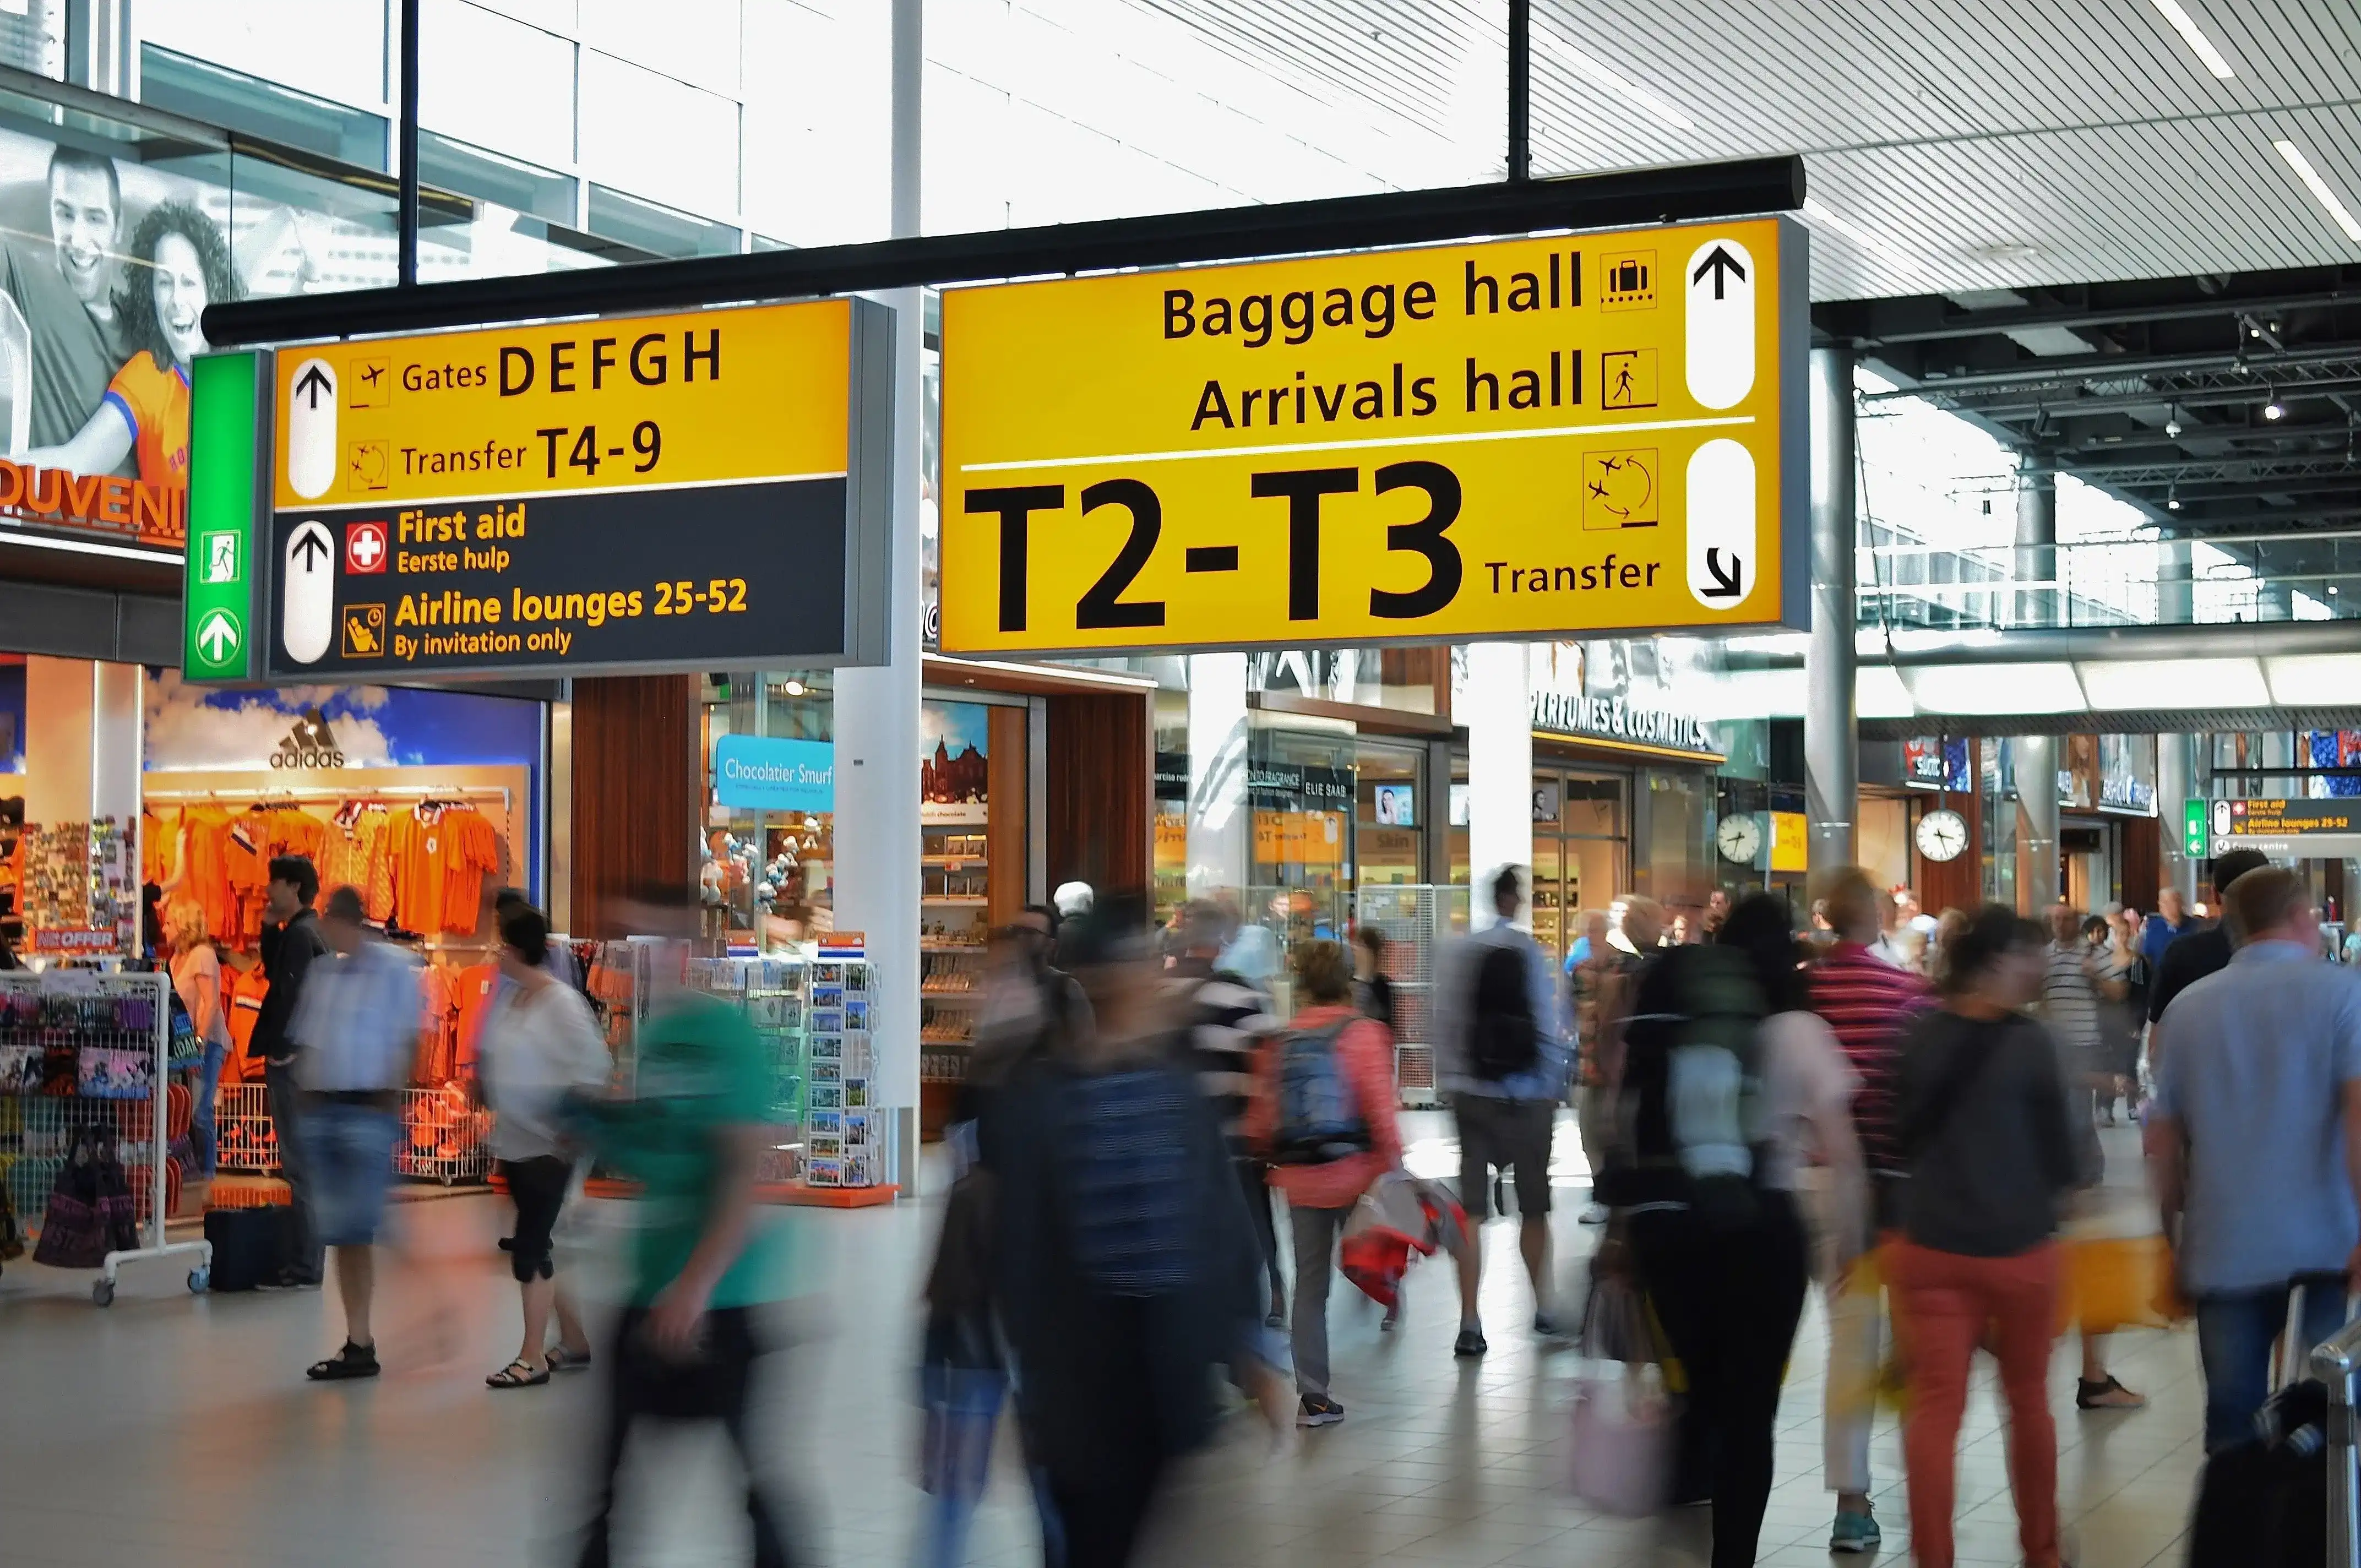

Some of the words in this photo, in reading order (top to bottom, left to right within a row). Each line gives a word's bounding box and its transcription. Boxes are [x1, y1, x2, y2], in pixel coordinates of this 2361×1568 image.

[1163, 277, 1437, 348] Baggage
[1465, 251, 1582, 316] hall
[402, 362, 487, 391] Gates
[1190, 363, 1438, 431] Arrivals
[1465, 349, 1583, 412] hall
[401, 440, 527, 475] Transfer
[536, 421, 661, 478] T4-9
[399, 510, 466, 543] First
[476, 503, 525, 540] aid
[398, 551, 458, 573] Eerste
[465, 545, 510, 573] hulp
[965, 460, 1463, 632] T2-T3
[1485, 554, 1660, 594] Transfer
[395, 591, 501, 626] Airline
[513, 587, 643, 627] lounges
[654, 579, 747, 615] 25-52
[395, 634, 418, 661] By
[425, 630, 520, 655] invitation
[527, 627, 572, 655] only
[1626, 710, 1709, 746] COSMETICS
[270, 747, 345, 768] adidas
[725, 758, 795, 783] Chocolatier
[798, 763, 833, 785] Smurf
[1305, 782, 1324, 796] ELIE
[1326, 783, 1347, 798] SAAB
[1377, 832, 1409, 848] Skin
